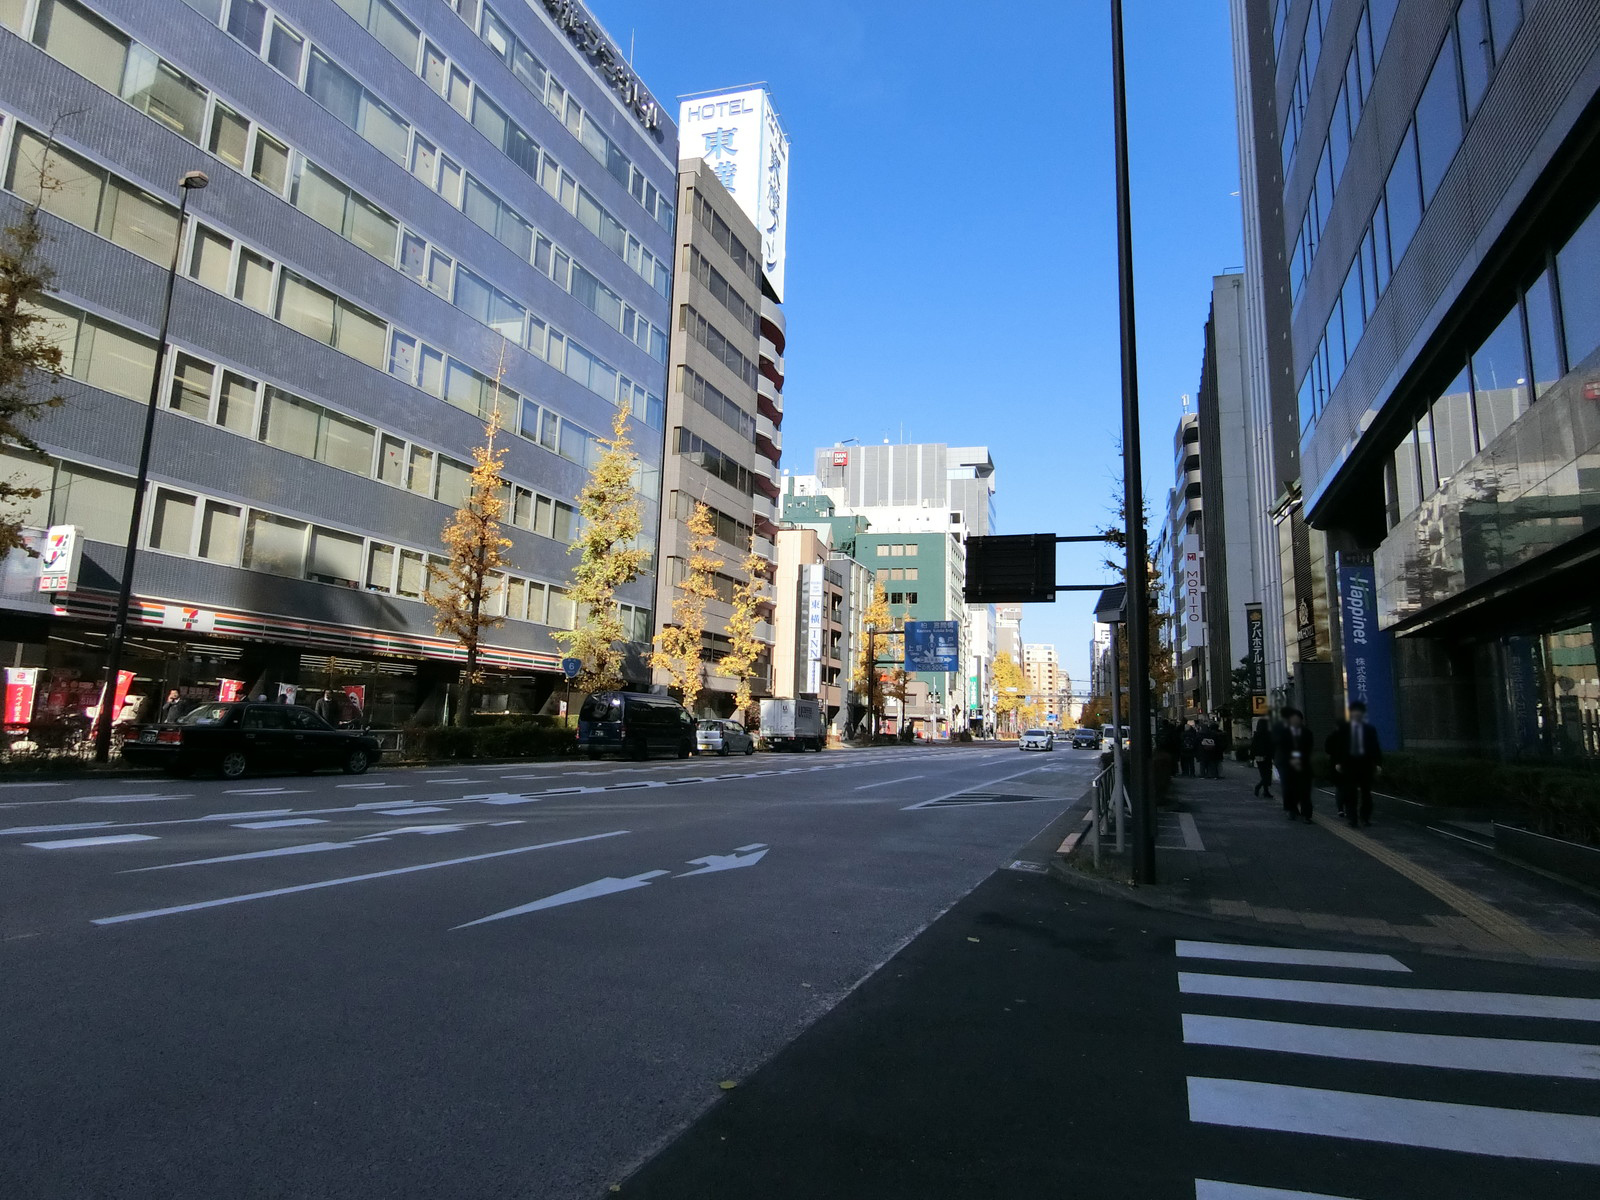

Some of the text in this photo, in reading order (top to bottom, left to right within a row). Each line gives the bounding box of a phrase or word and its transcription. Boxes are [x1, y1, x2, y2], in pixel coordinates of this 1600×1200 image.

[688, 98, 754, 123] HOTEL
[1186, 571, 1200, 622] MORITO
[1347, 575, 1369, 646] Happinet
[810, 600, 820, 624] 東横
[809, 630, 819, 658] INN
[1251, 621, 1263, 664] アパホテル
[568, 662, 575, 670] 6
[1355, 657, 1368, 702] 株式会社ハ
[1256, 698, 1265, 709] P
